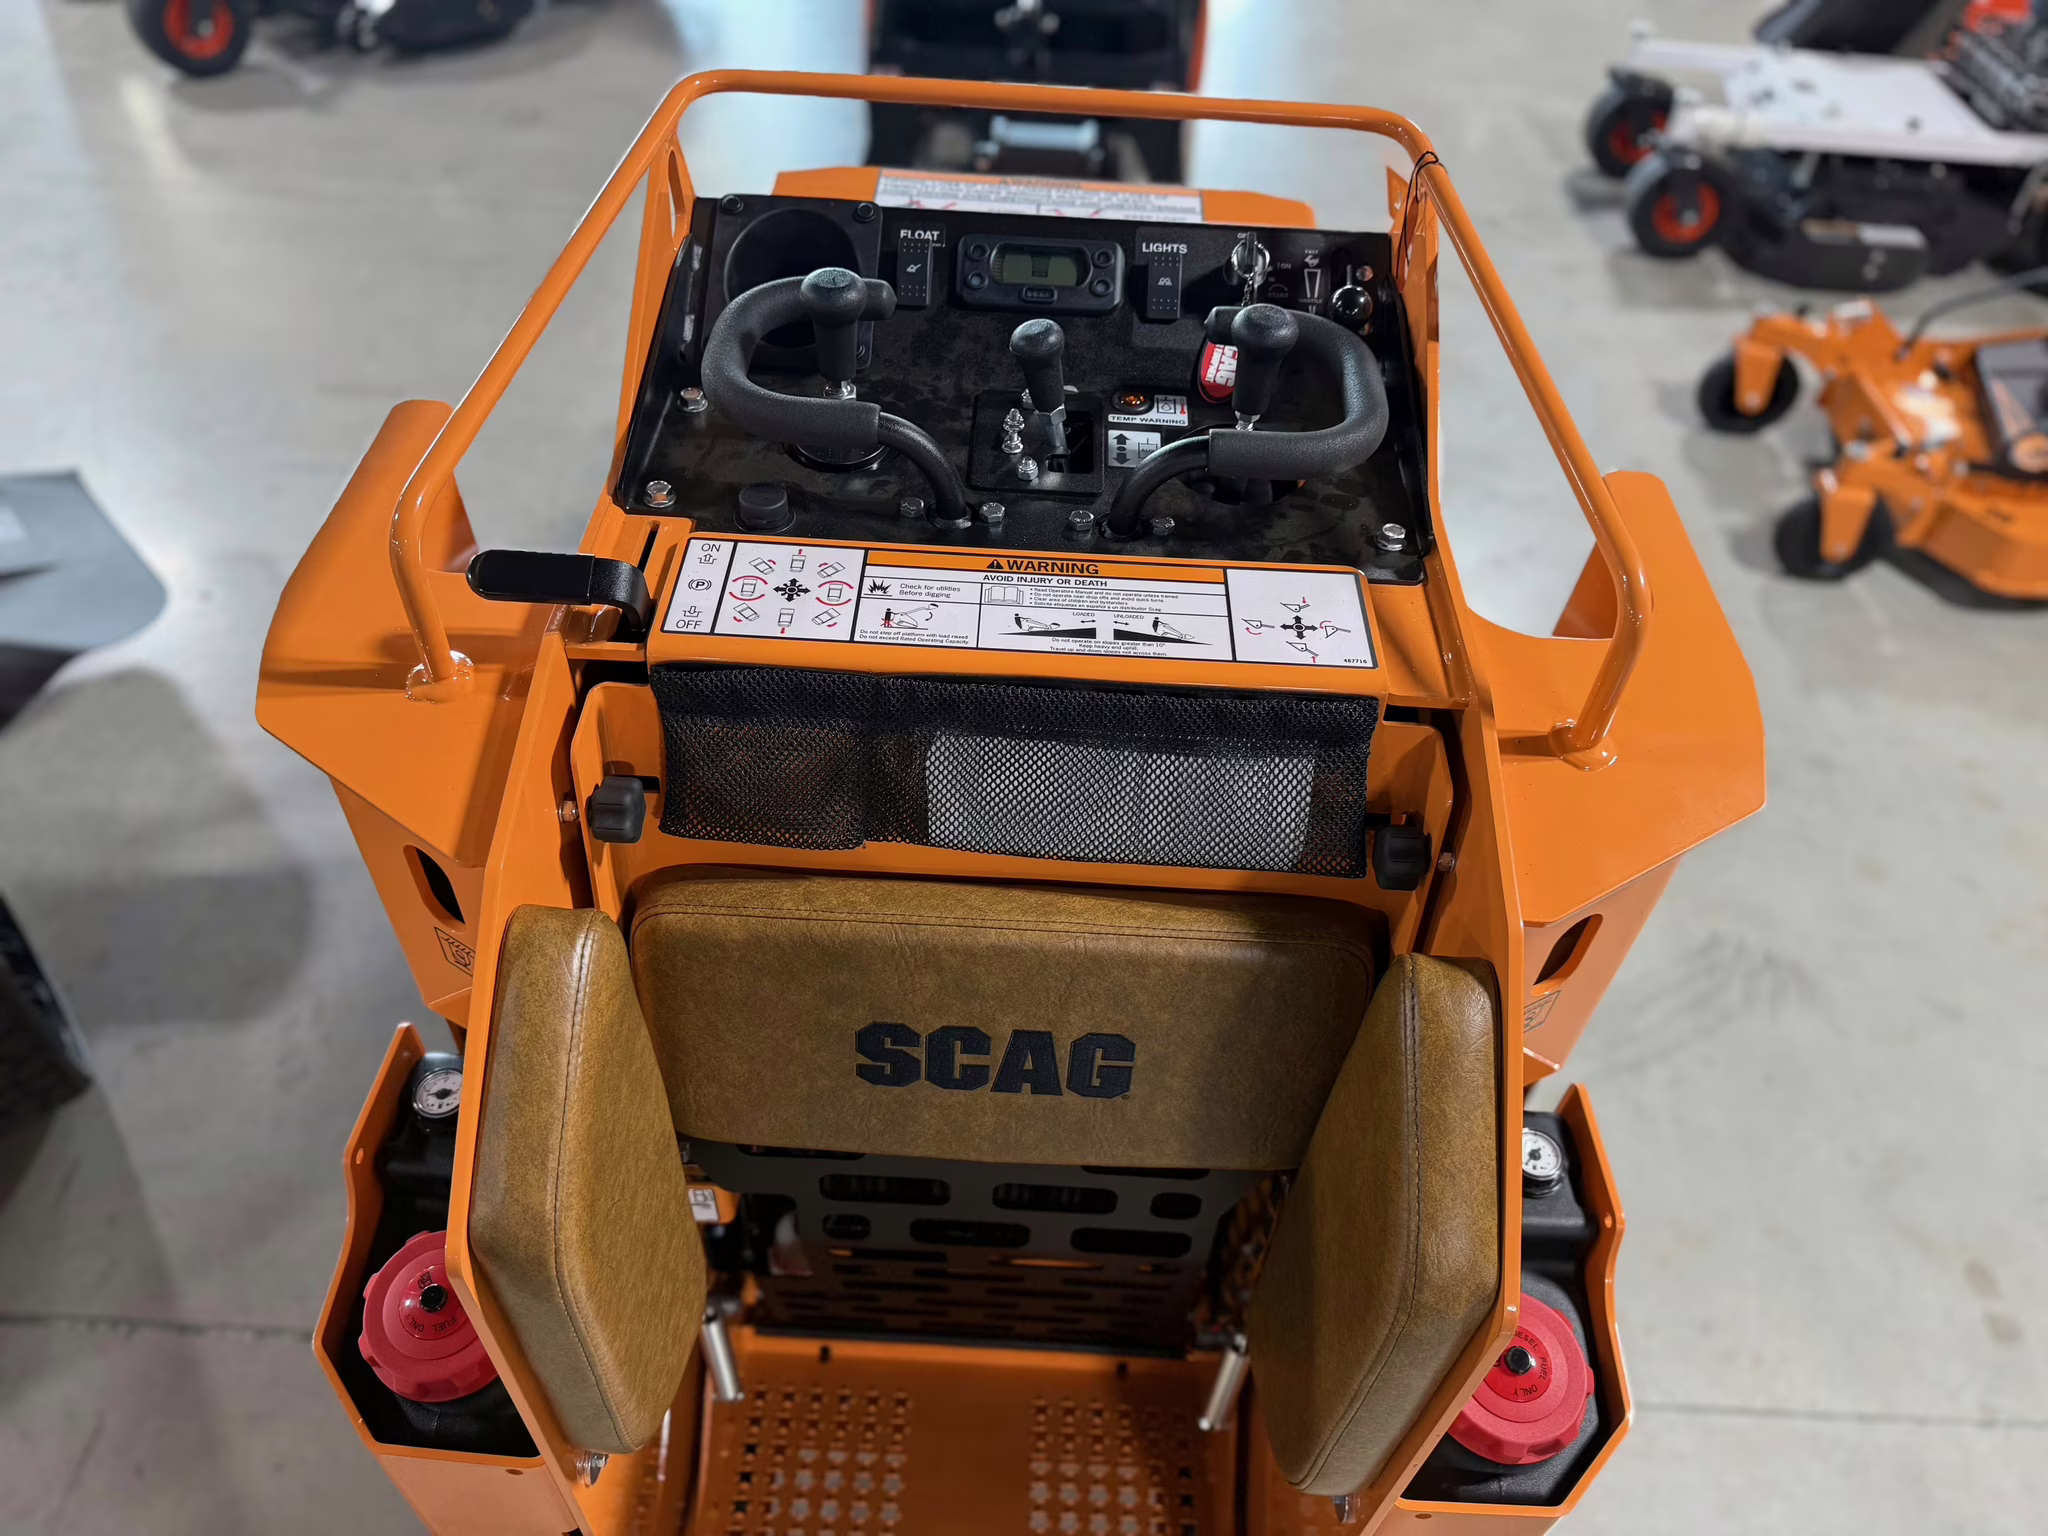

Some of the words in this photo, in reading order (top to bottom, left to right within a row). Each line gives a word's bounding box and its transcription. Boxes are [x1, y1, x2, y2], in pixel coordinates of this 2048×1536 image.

[899, 229, 940, 240] FLOAT
[1142, 241, 1188, 254] LIGHTS
[1214, 344, 1238, 387] CAG
[1139, 416, 1186, 425] WARNING
[701, 543, 721, 553] ON
[1006, 559, 1100, 575] WARNING
[983, 574, 1014, 583] AVOID
[1016, 576, 1054, 585] INJURY
[1056, 578, 1071, 586] OR
[1074, 579, 1108, 587] DEATH
[899, 589, 923, 597] Before
[675, 619, 703, 630] OFF
[854, 1020, 1137, 1099] SCAG
[431, 1315, 457, 1333] FUEL
[1515, 1330, 1539, 1351] IESEL
[1537, 1356, 1548, 1380] FUEL
[1512, 1384, 1538, 1397] ONLY
